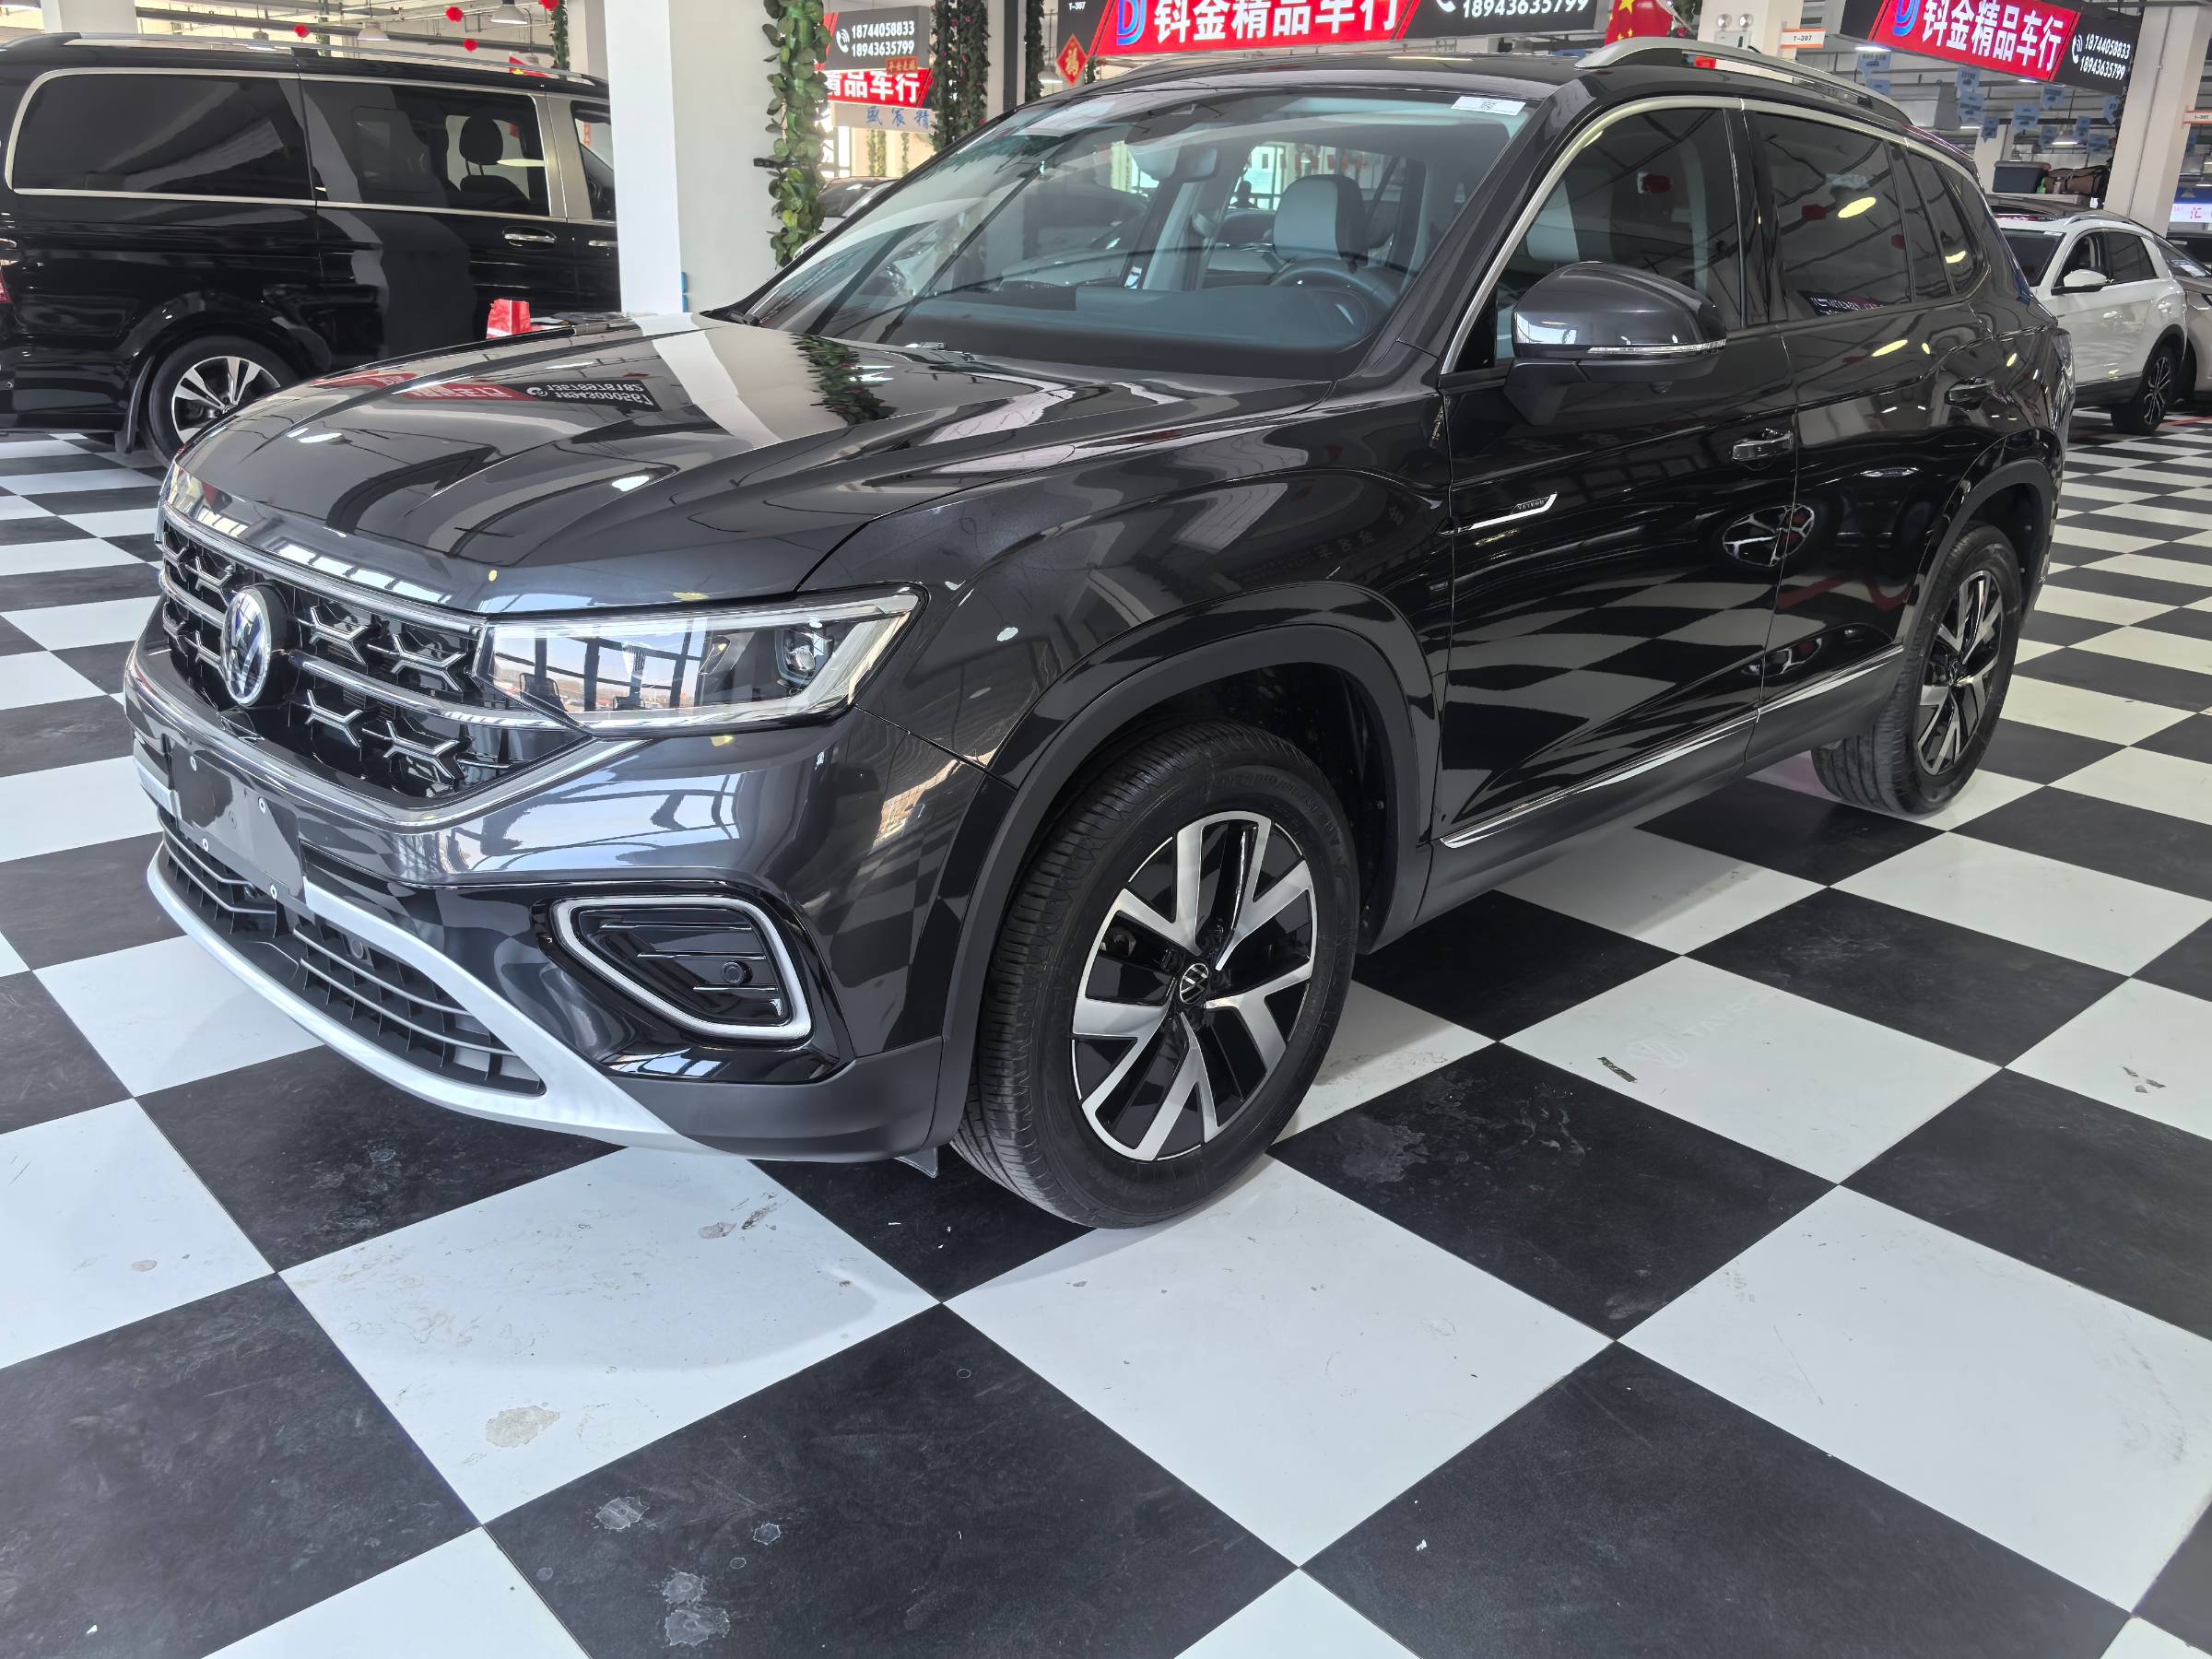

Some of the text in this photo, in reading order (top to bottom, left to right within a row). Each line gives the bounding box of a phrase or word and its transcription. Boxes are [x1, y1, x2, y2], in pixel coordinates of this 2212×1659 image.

[1463, 0, 1589, 18] 18943635799
[852, 20, 915, 39] 18744058833
[852, 40, 915, 58] 18943635799
[2085, 33, 2131, 60] 18744058833
[2079, 55, 2126, 81] 18943635799
